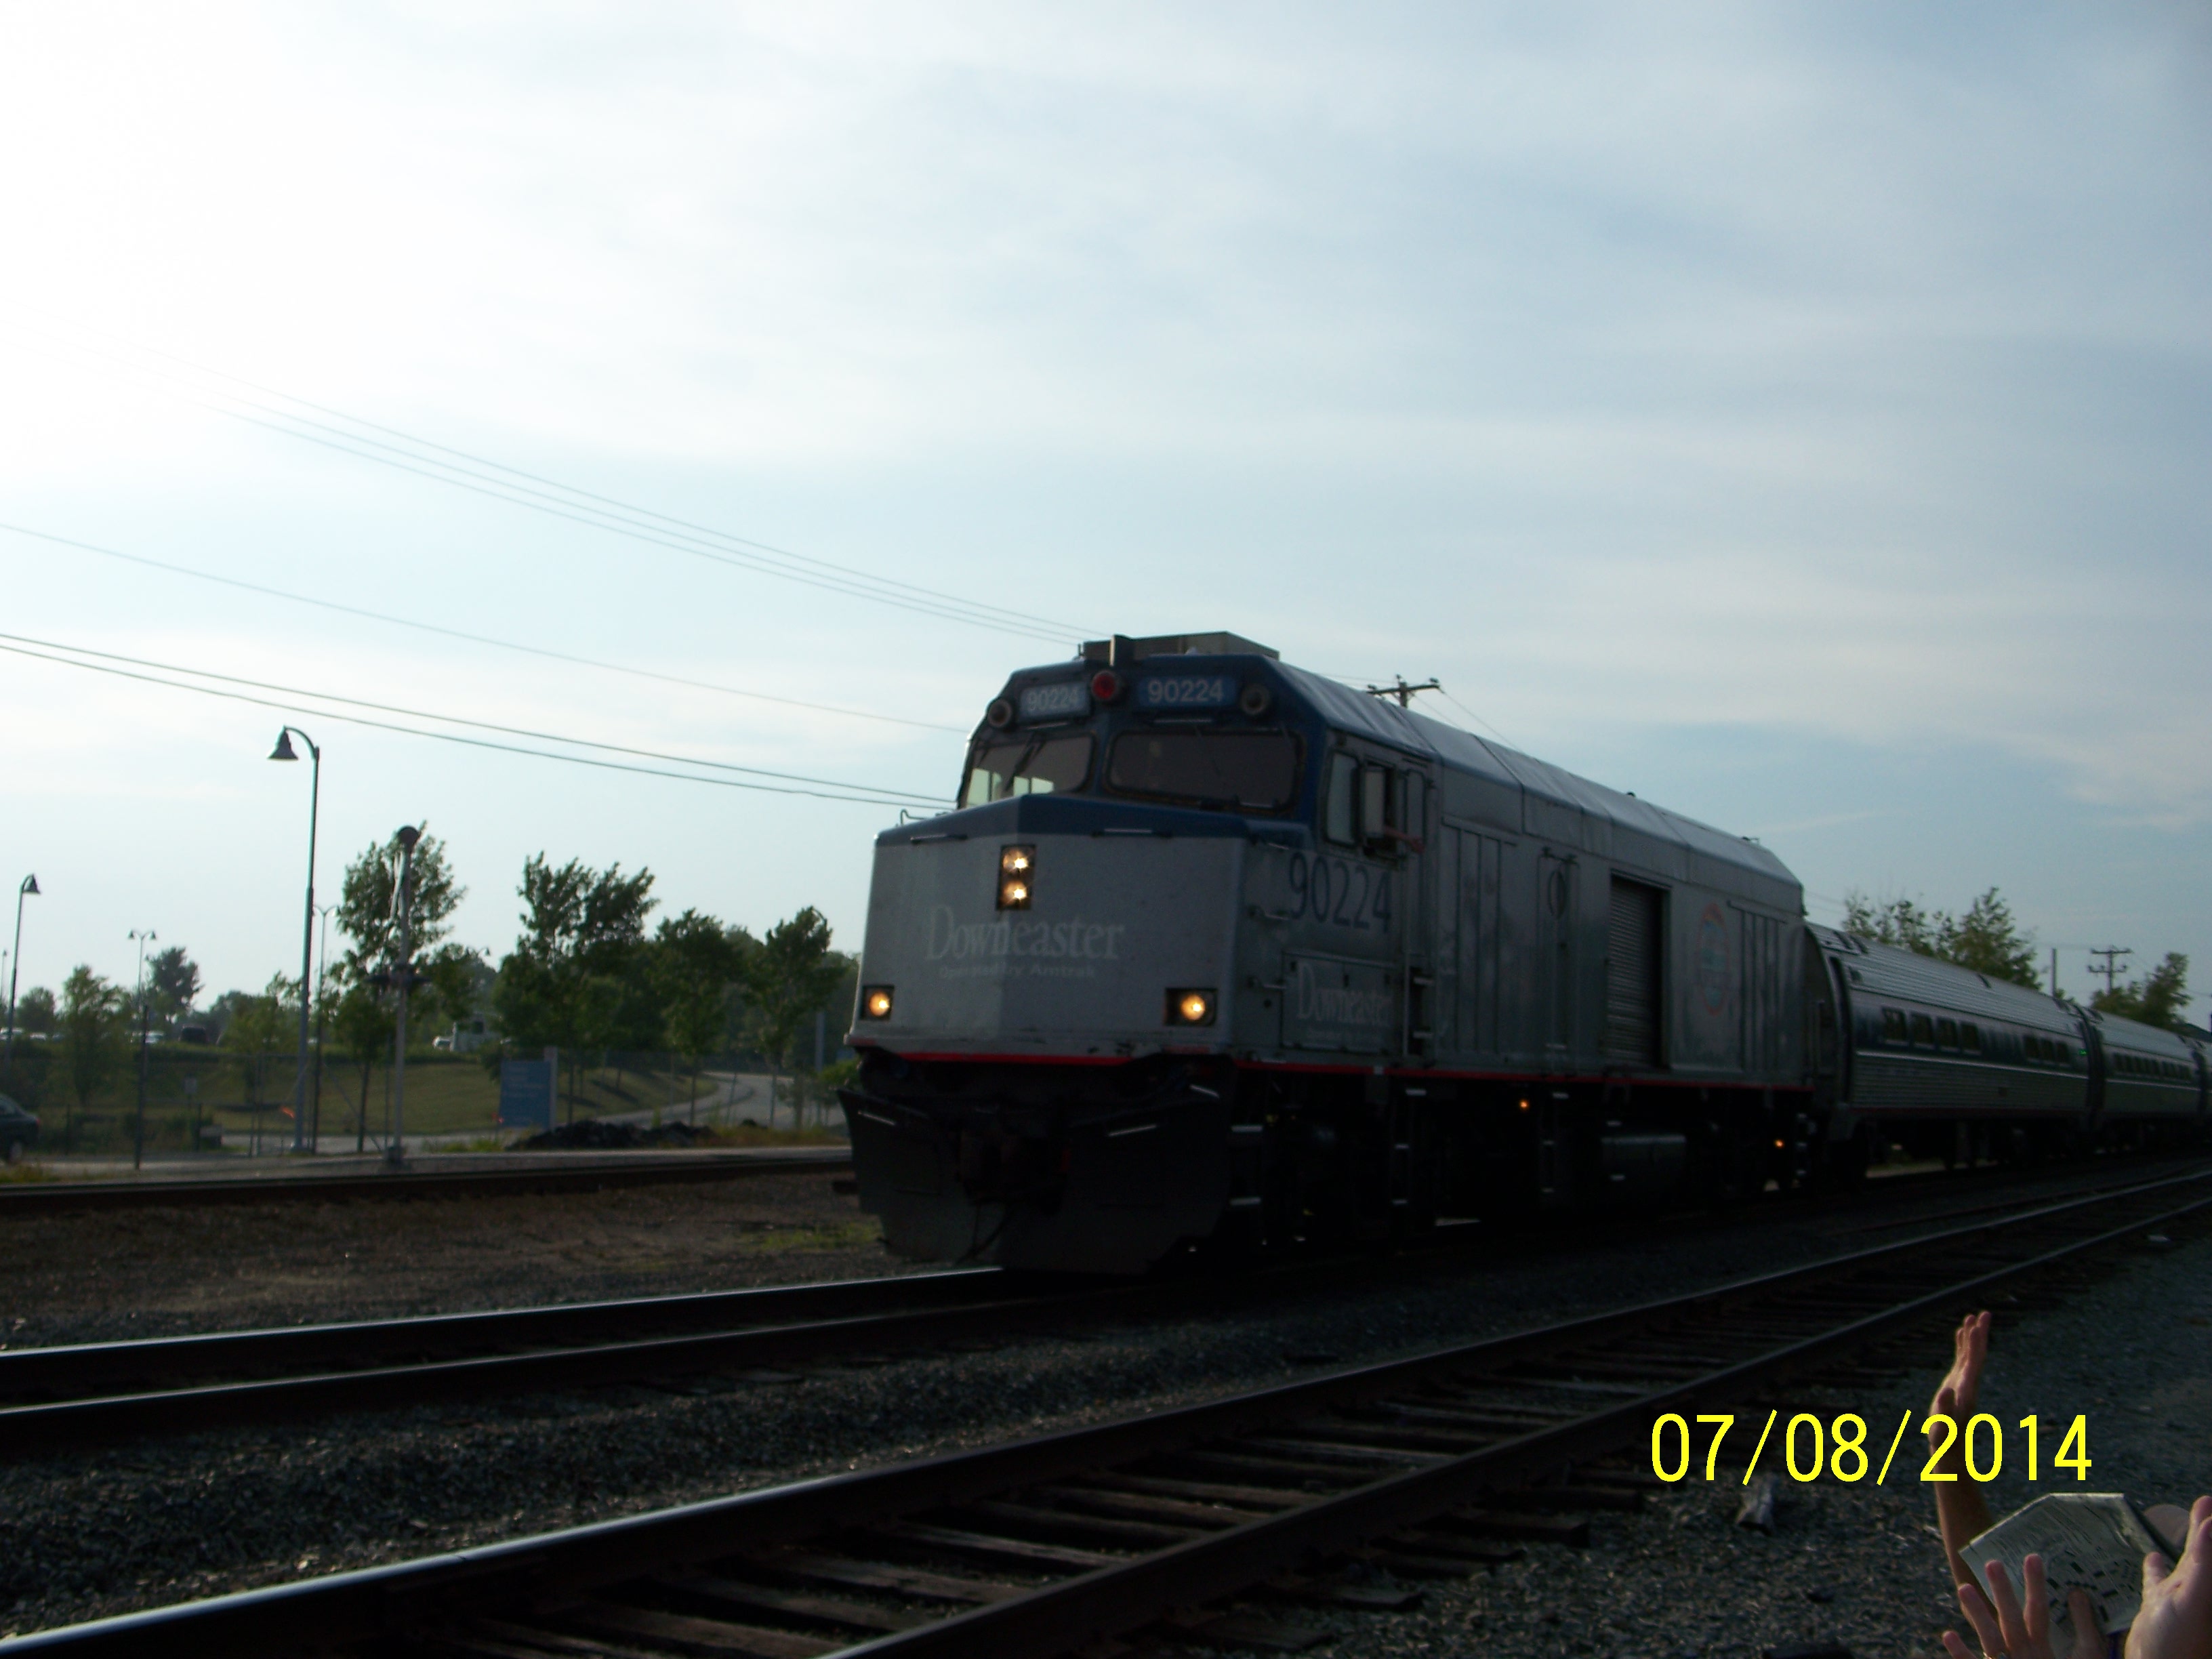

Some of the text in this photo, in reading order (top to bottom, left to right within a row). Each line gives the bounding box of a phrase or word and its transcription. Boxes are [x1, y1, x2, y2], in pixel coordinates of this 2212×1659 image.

[1027, 687, 1084, 712] 90224
[1148, 678, 1224, 703] 90224
[1290, 852, 1391, 933] 90224
[924, 903, 1124, 960] Downeaster
